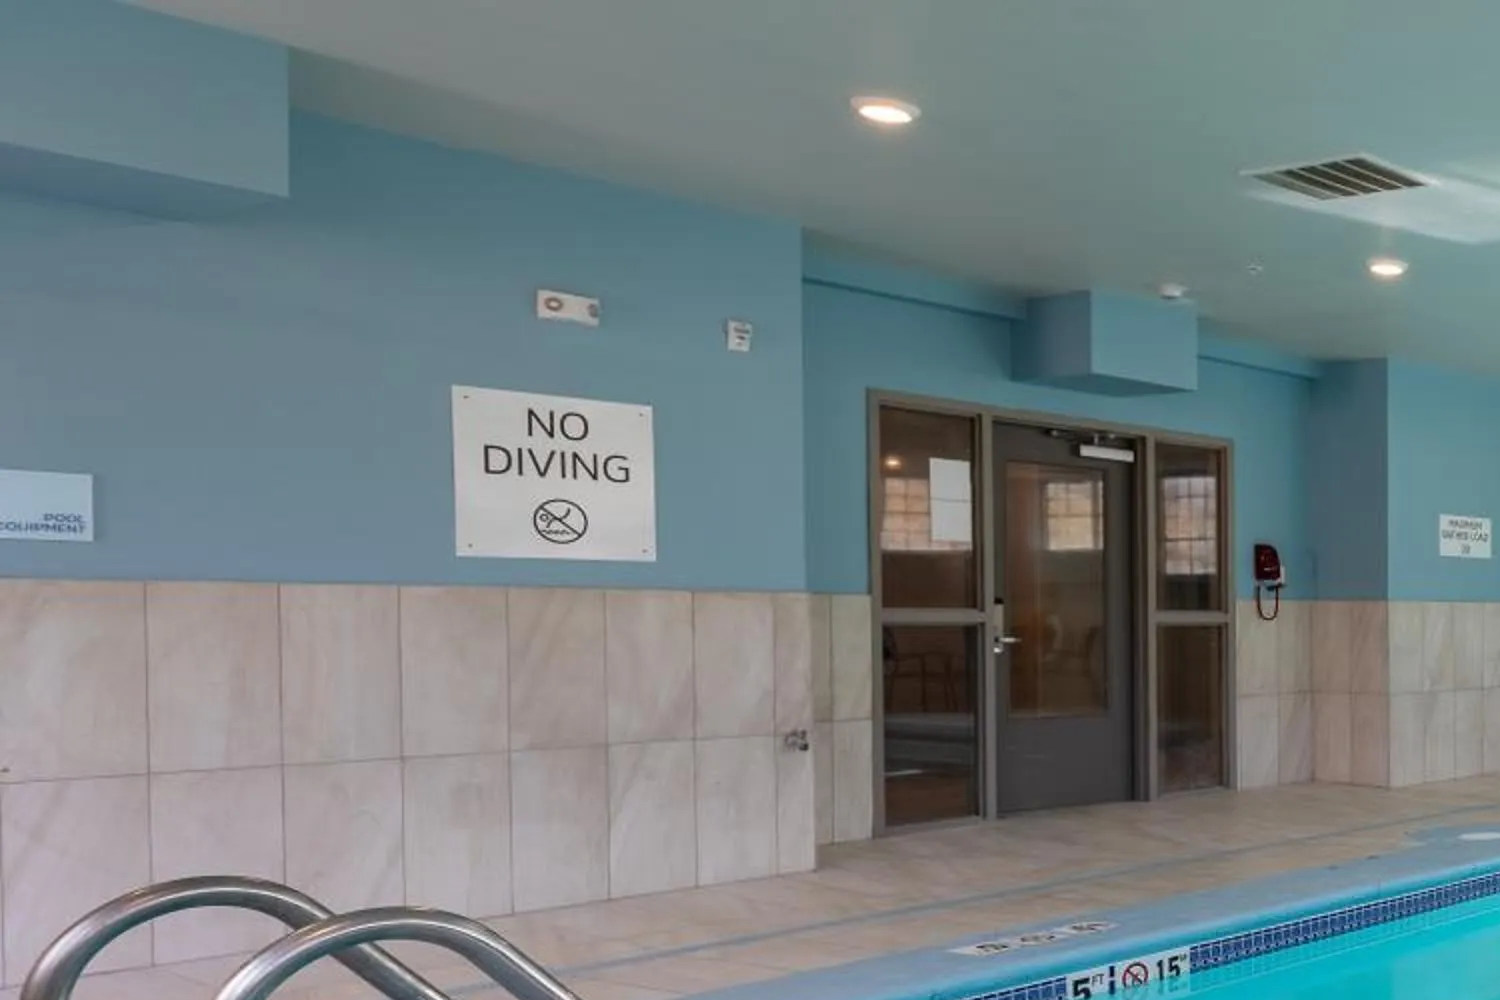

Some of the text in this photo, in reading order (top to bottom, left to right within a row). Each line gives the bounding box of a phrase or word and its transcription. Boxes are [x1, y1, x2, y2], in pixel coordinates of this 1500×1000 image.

[527, 407, 589, 441] NO
[483, 444, 631, 483] DIVING
[43, 513, 85, 523] POOL
